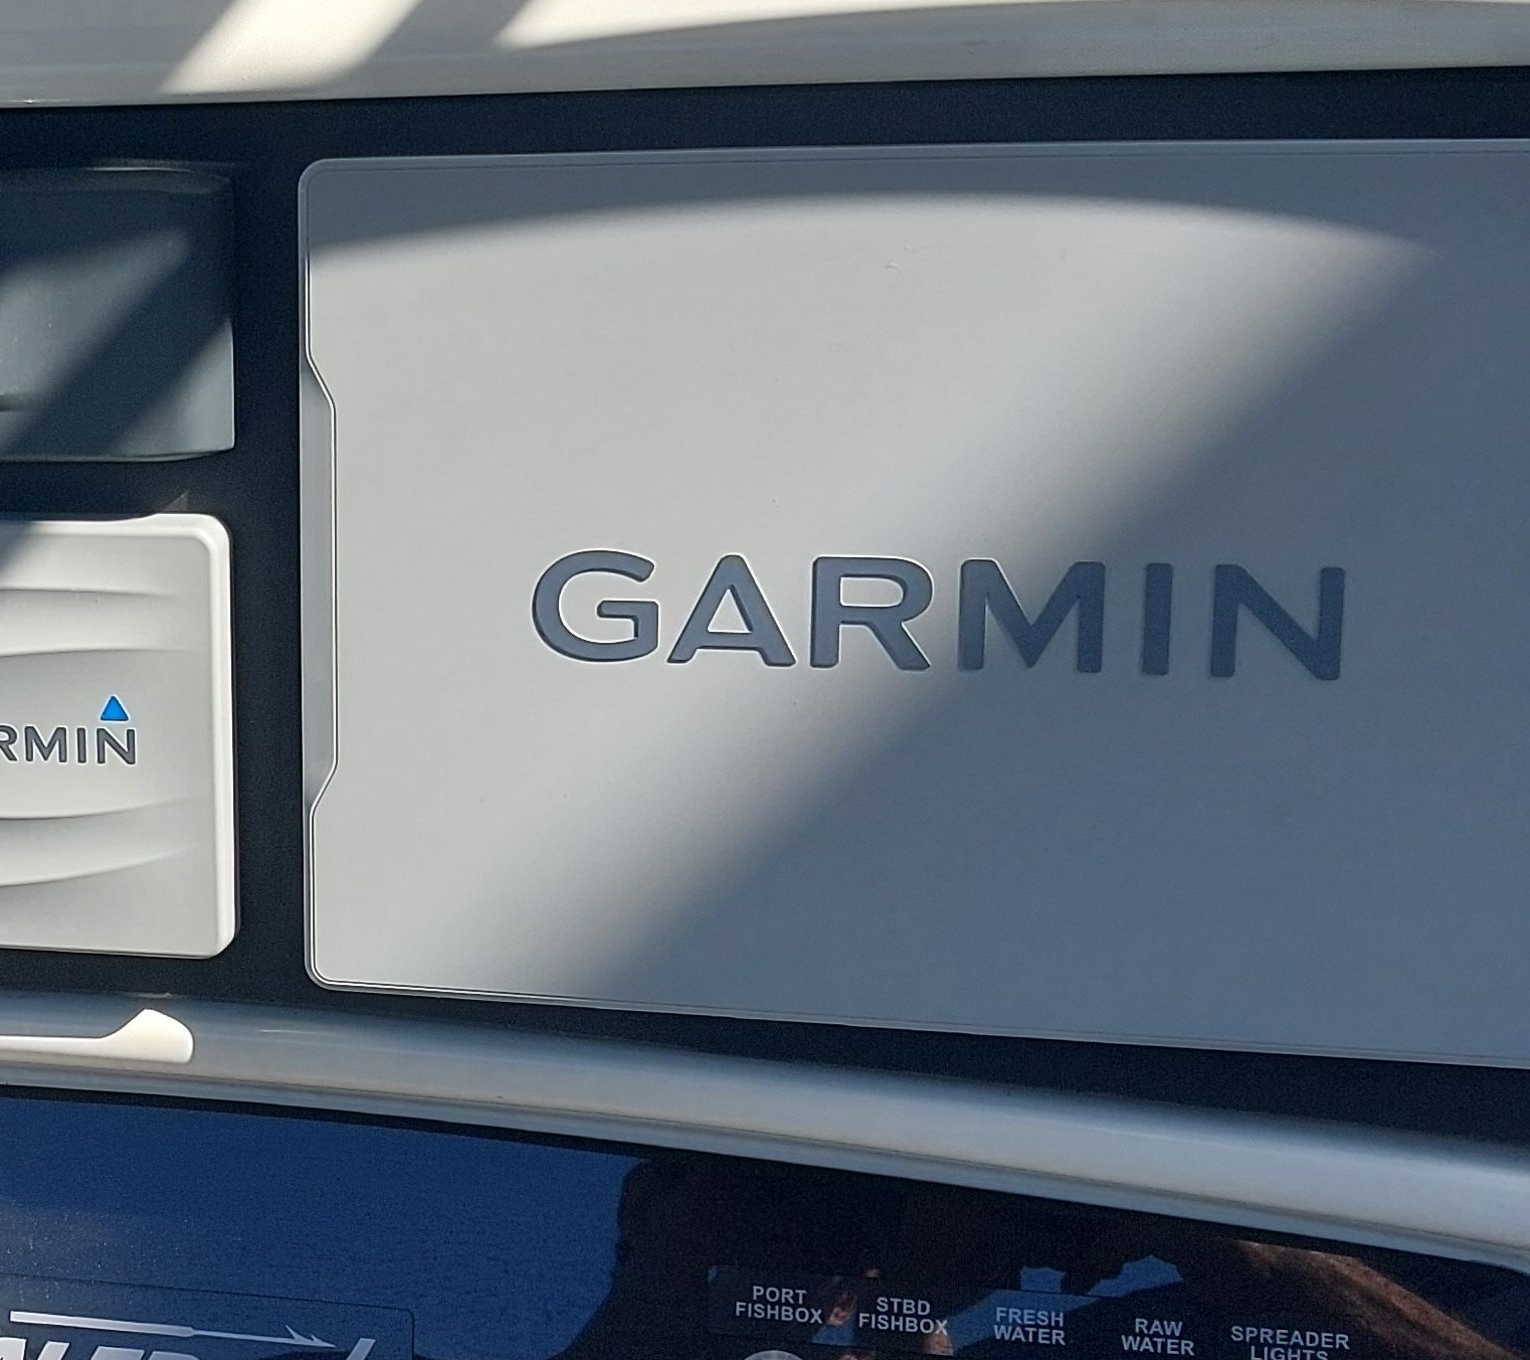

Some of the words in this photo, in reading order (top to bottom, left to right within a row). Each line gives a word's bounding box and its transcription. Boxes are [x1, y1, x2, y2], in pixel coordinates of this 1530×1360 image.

[530, 547, 1348, 682] GARMIN
[752, 1285, 807, 1305] PORT
[876, 1296, 931, 1315] STBD
[735, 1301, 823, 1324] FISHBOX
[995, 1306, 1065, 1327] FRESH
[858, 1313, 948, 1336] FISHBOX
[993, 1324, 1066, 1345] WATER
[1135, 1318, 1182, 1337] RAW
[1121, 1335, 1195, 1356] WATER
[1230, 1325, 1350, 1350] SPREADER
